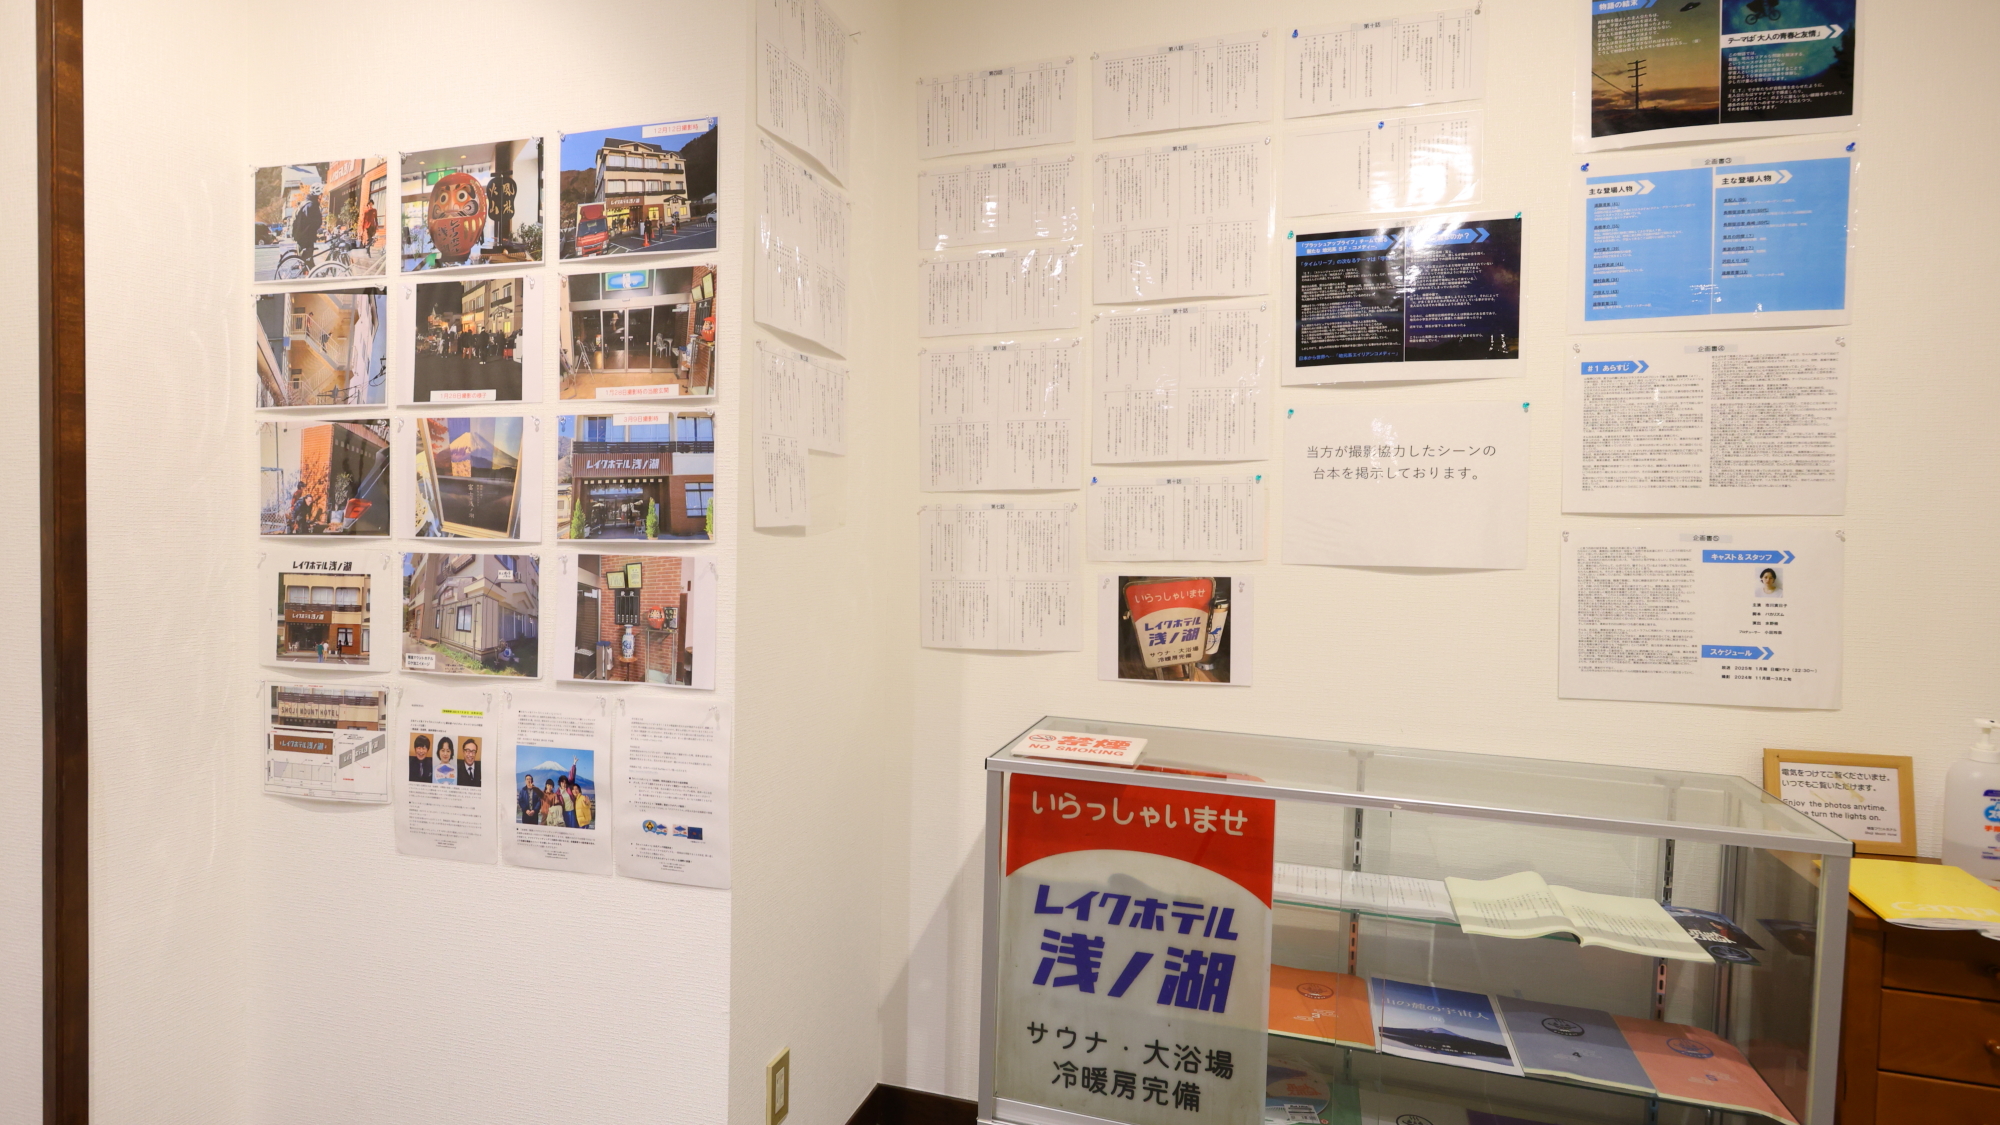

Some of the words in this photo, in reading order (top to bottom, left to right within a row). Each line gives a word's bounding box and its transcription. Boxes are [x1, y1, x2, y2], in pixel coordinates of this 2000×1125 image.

[1599, 0, 1638, 10] 物語の結末
[1722, 174, 1772, 185] 主な登場人物
[1589, 185, 1633, 195] 主な登場人物
[1602, 363, 1630, 371] あらすじ
[1306, 444, 1497, 459] 当方が撮影協力したシーンの
[1312, 466, 1480, 481] 台本を掲示しております。
[293, 561, 352, 571] レイクホテル浅ノ湖
[1135, 588, 1205, 603] いらっしゃいませ
[1145, 617, 1201, 631] レイクホテル
[1149, 628, 1200, 646] 浅ノ湖
[1057, 734, 1133, 752] 禁煙
[1055, 745, 1124, 757] SMOKING
[1031, 790, 1248, 837] いらっしゃいませ
[1034, 884, 1238, 941] レイクホテル
[1032, 928, 1236, 1013] 浅ノ湖
[1027, 1021, 1234, 1080] サウナ・大浴場
[1052, 1060, 1201, 1112] 冷暖房完備
